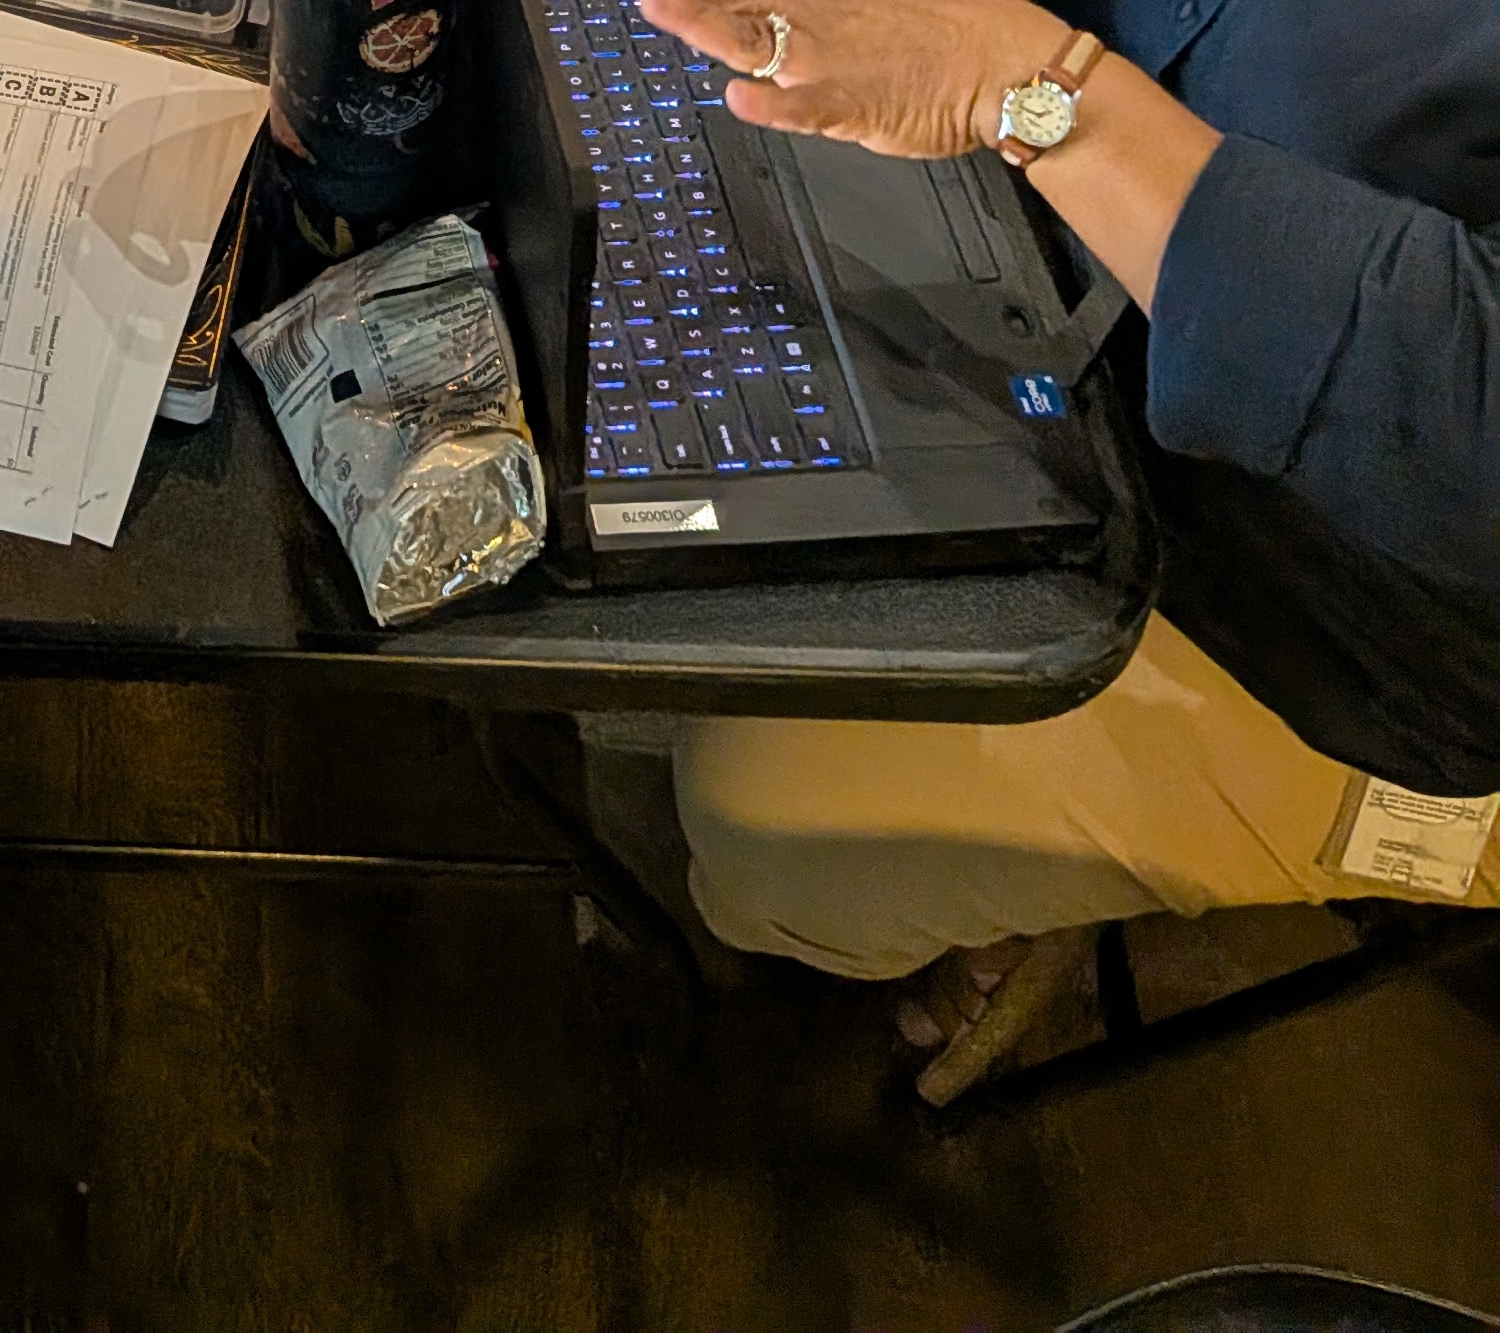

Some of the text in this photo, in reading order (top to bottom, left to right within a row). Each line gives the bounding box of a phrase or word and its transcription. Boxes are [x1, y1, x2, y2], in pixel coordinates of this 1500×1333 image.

[5, 80, 21, 91] C
[39, 86, 56, 96] B
[72, 91, 90, 101] A
